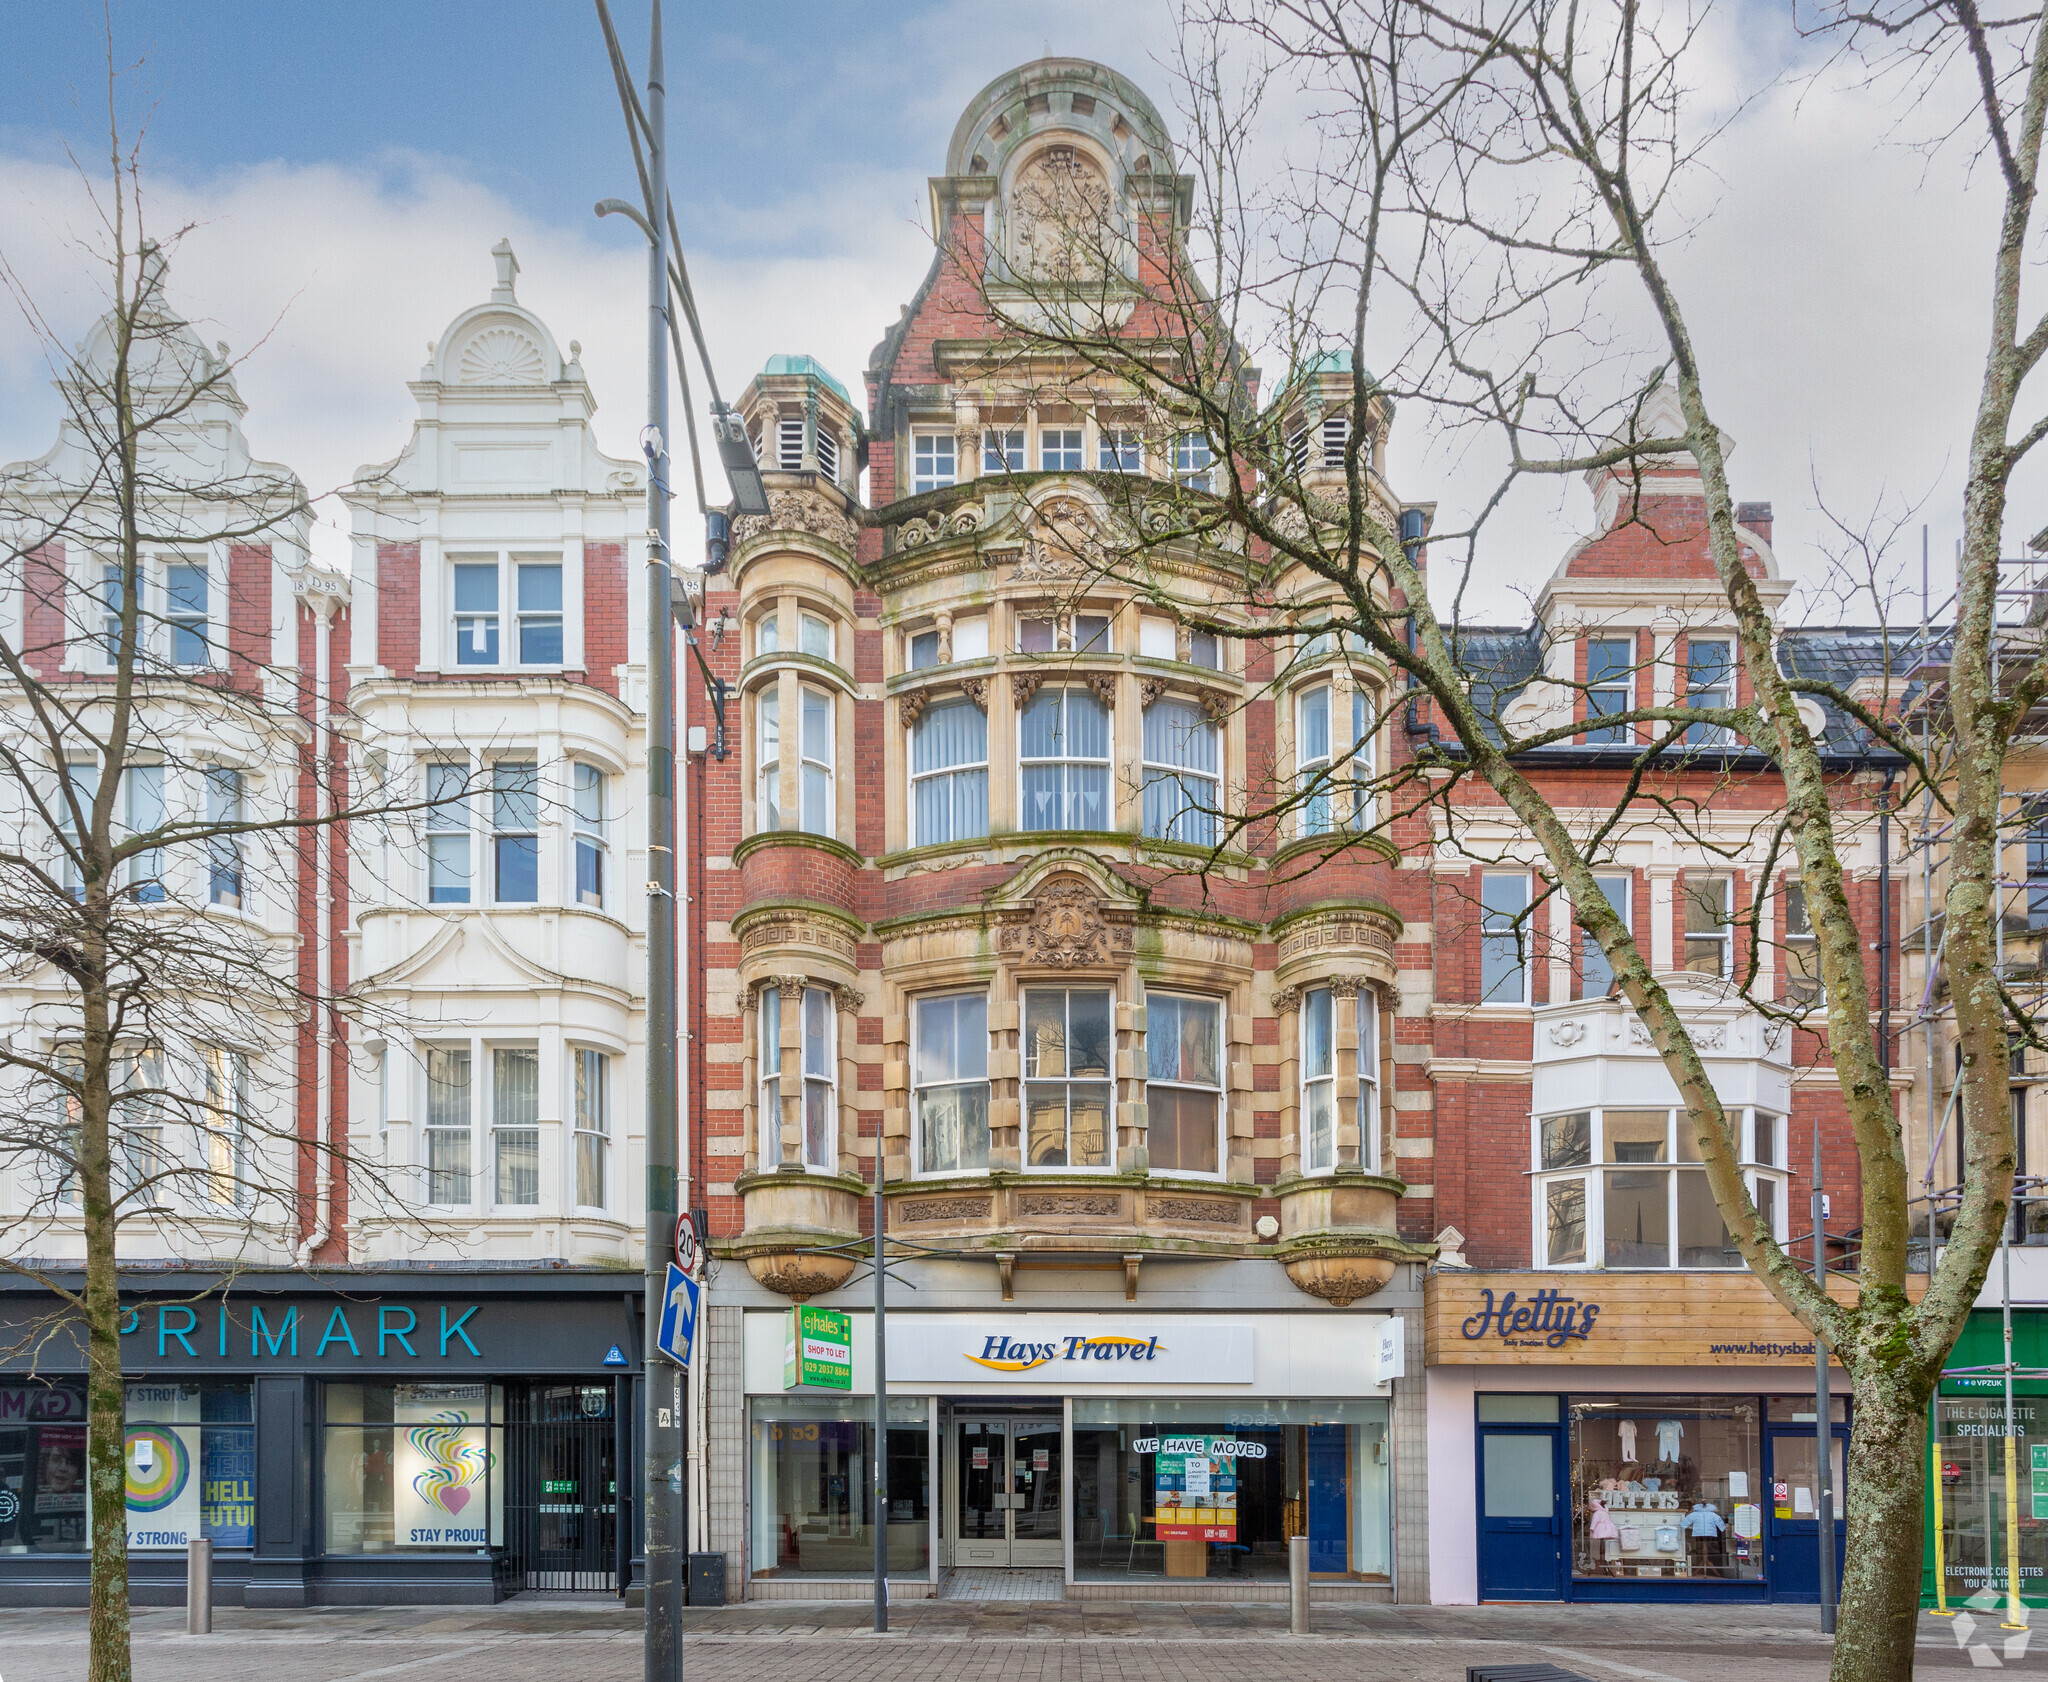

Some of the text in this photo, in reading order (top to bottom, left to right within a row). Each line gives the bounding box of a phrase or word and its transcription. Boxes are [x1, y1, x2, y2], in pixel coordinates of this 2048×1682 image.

[294, 576, 336, 591] 18 D 95
[687, 582, 698, 590] 95
[679, 1229, 693, 1258] 20
[804, 1312, 839, 1334] ejhales
[1462, 1289, 1600, 1348] Hetty's
[1519, 1339, 1543, 1347] Boutique
[807, 1344, 846, 1358] SHOP TO LET
[979, 1336, 1158, 1366] Hays Travel
[804, 1361, 849, 1376] 029 2037 8844
[661, 1412, 669, 1424] A
[1946, 1407, 2035, 1419] THE E-CIGAETTE
[1135, 1440, 1264, 1456] WE HAVE MOVED
[206, 1481, 254, 1501] HELL
[136, 1531, 187, 1545] STRONG
[410, 1529, 486, 1542] STAY PROUD
[1945, 1567, 1993, 1576] ELECTRONIC
[1964, 1579, 2026, 1588] YOU CAN TRST
